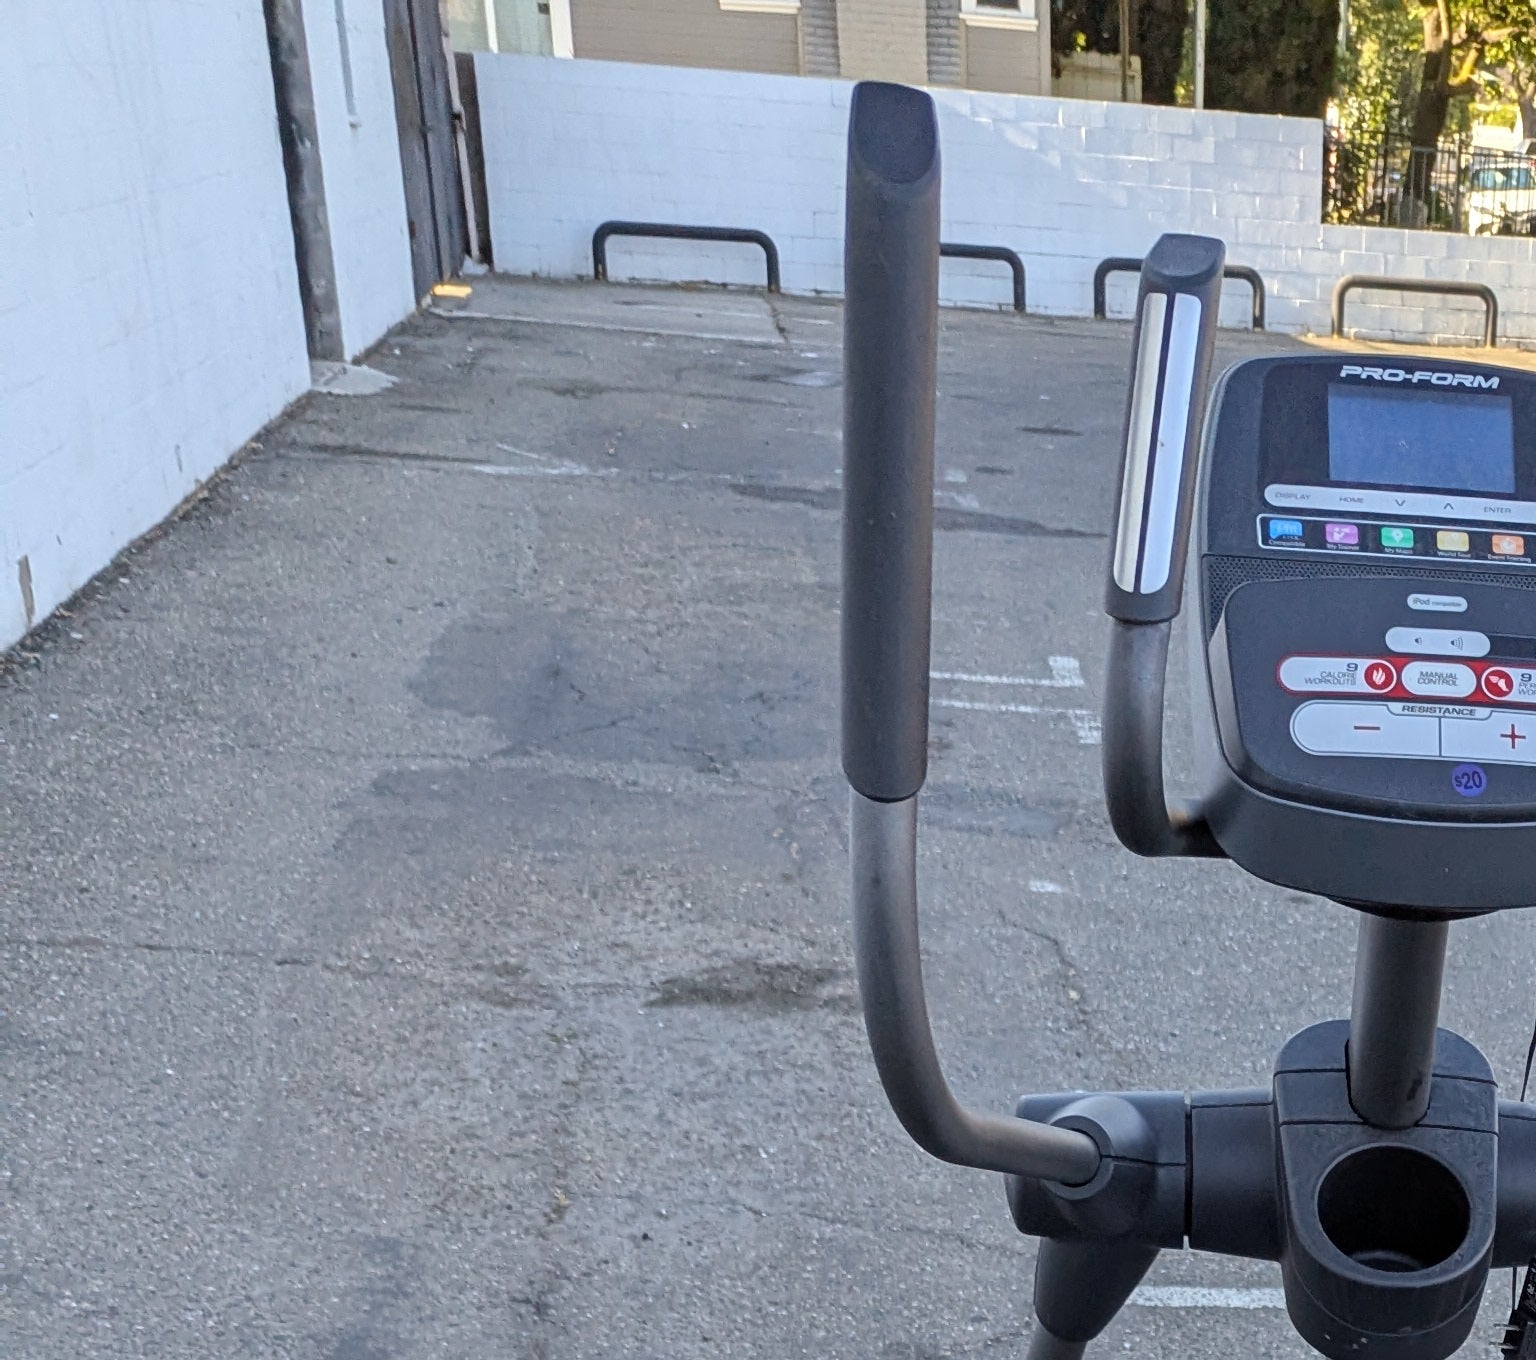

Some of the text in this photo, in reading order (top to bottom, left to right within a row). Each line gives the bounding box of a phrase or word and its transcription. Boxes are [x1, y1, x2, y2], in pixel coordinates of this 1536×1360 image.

[1339, 364, 1500, 390] PRO-FORM
[1274, 491, 1312, 500] DISPLAY
[1339, 496, 1365, 504] HOME
[1483, 506, 1512, 514] ENTER
[1412, 597, 1431, 606] iPod
[1346, 662, 1359, 672] 9
[1319, 671, 1357, 679] CALORIE
[1419, 671, 1459, 681] MANUAL
[1520, 673, 1533, 683] 9
[1304, 677, 1357, 686] WORKOUTS
[1417, 678, 1459, 687] CONTROL
[1401, 705, 1477, 717] RESISTANCE
[1454, 770, 1483, 790] $20
